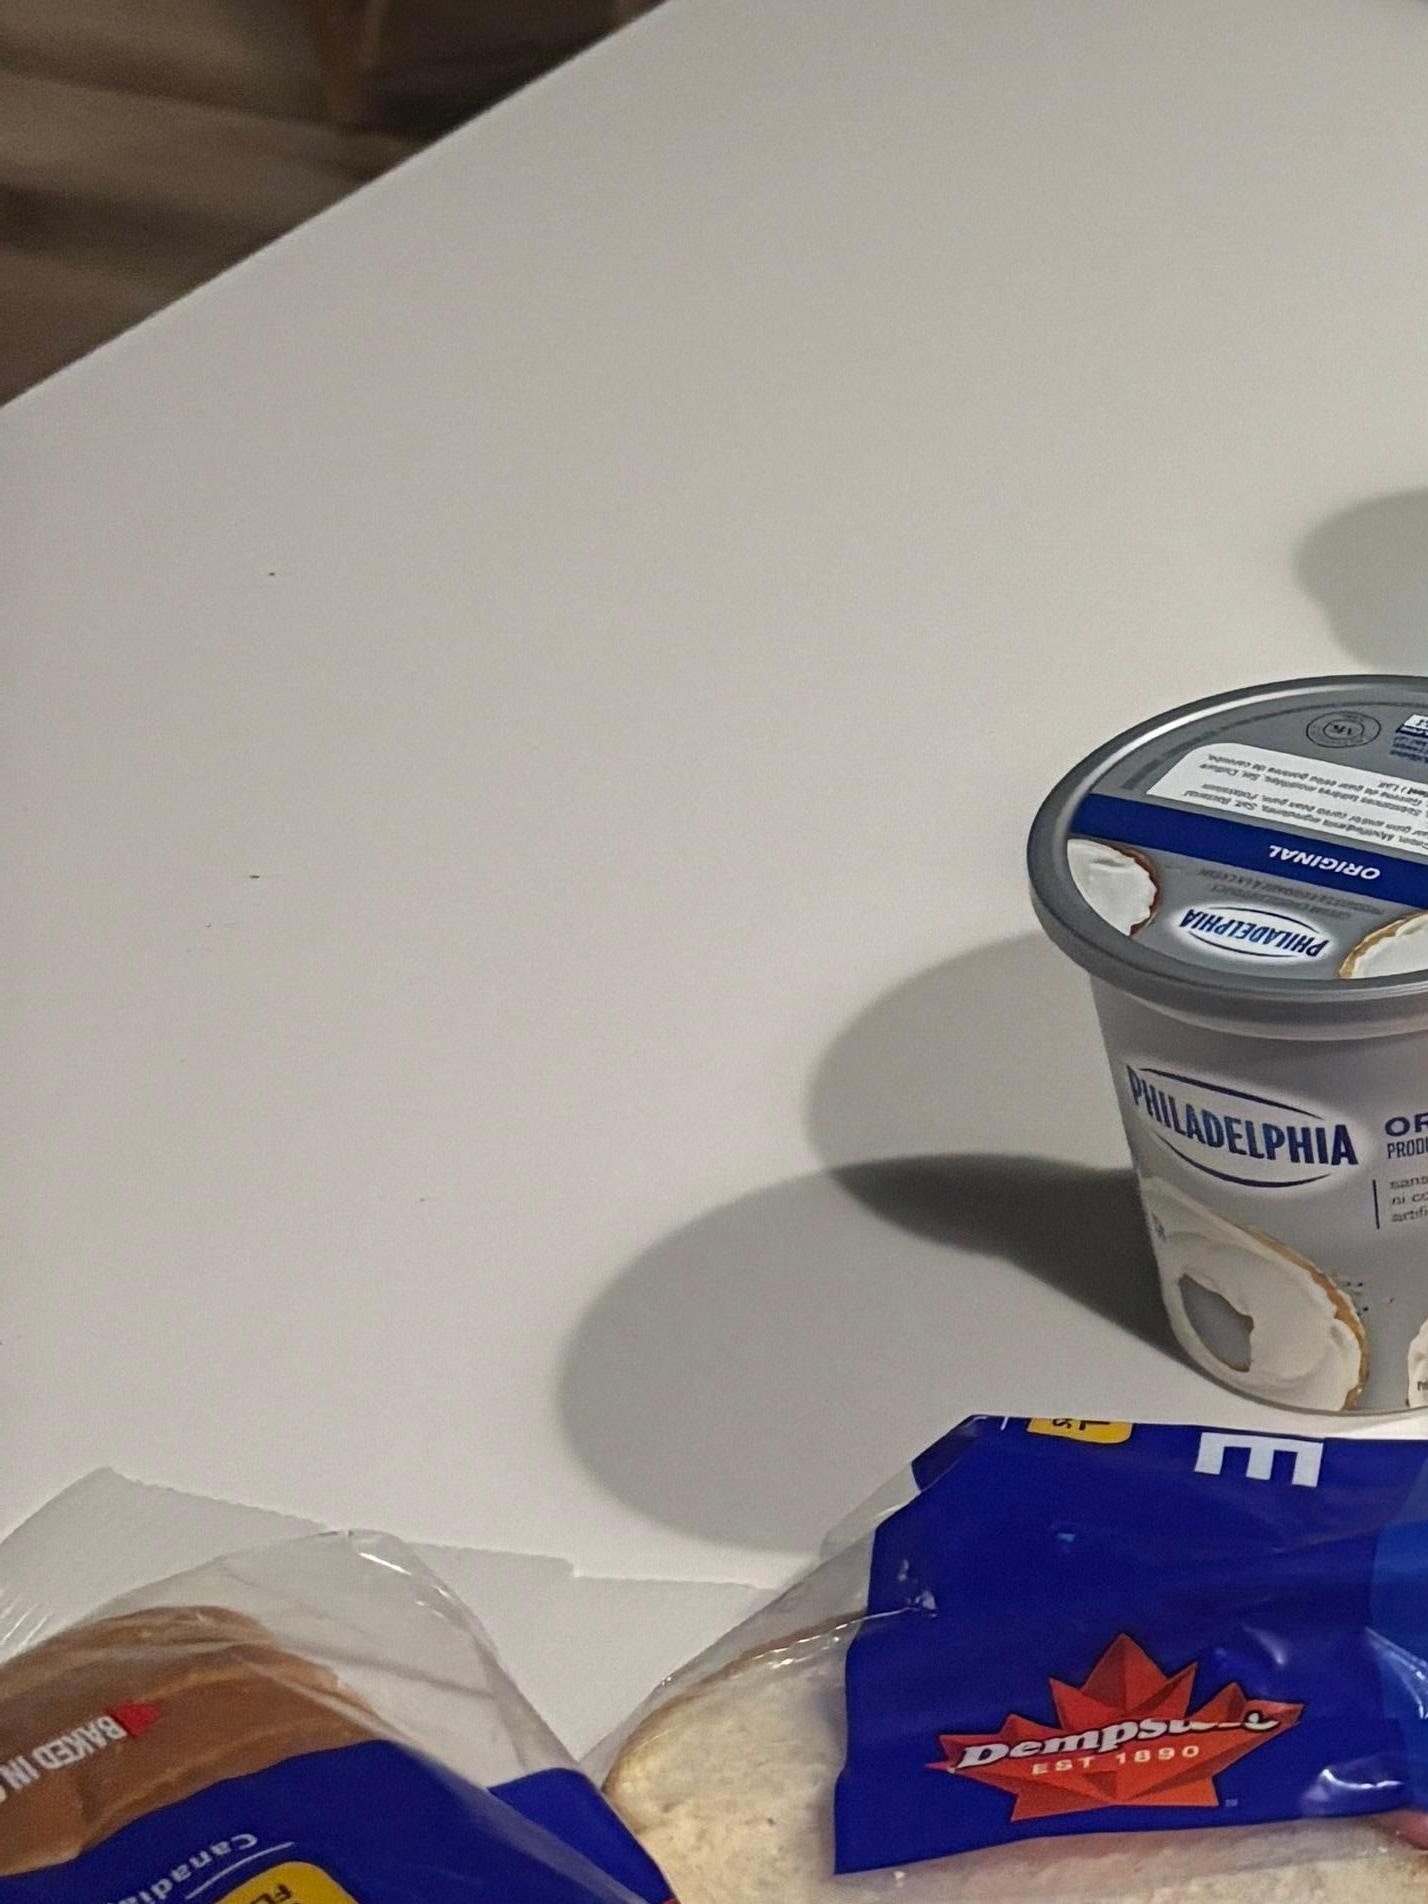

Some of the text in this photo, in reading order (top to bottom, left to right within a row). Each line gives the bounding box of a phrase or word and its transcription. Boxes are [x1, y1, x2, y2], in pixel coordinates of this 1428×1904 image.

[1268, 844, 1380, 880] ORIGINAL
[1180, 907, 1330, 958] PHILADELPHIA
[1126, 1063, 1358, 1166] PHILADELPHIA
[4, 1715, 127, 1791] BAKED IN
[1030, 1744, 1201, 1776] EST 1890
